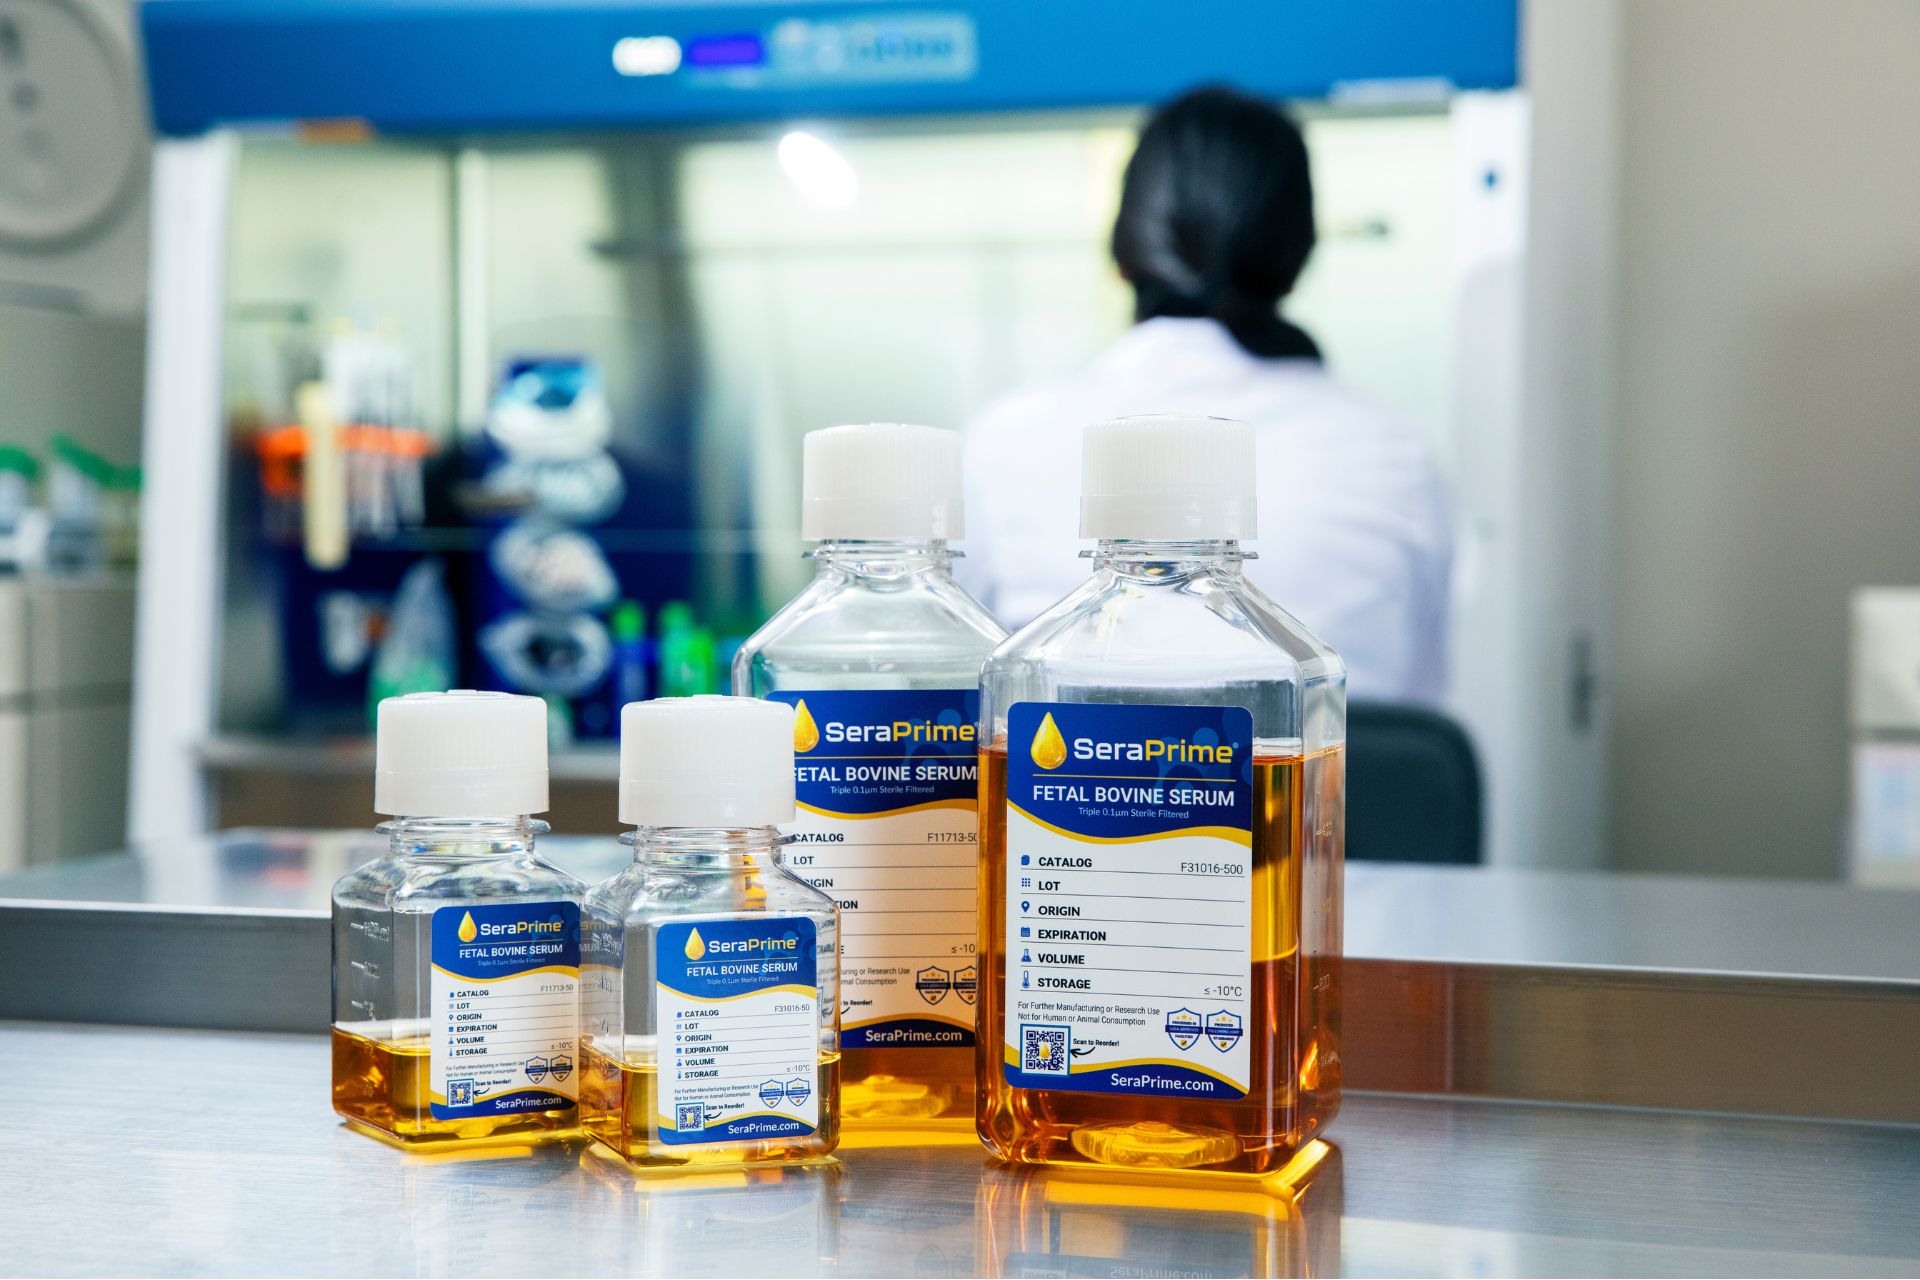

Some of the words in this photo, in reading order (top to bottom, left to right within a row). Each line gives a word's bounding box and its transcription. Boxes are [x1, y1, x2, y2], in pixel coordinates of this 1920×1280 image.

[846, 767, 911, 782] BOVINE
[916, 766, 977, 781] SERUM
[830, 786, 851, 795] Triple
[880, 786, 904, 794] Sterile
[905, 785, 935, 794] Filtered
[1033, 785, 1090, 802] FETAL
[1095, 787, 1164, 804] BOVINE
[1169, 789, 1235, 807] SERUM
[1078, 807, 1100, 817] Triple
[1131, 808, 1157, 818] Sterile
[1159, 809, 1189, 819] Filtered
[794, 856, 814, 865] LOT
[1039, 857, 1092, 868] CATALOG
[1181, 862, 1243, 875] F31016-500
[1039, 881, 1061, 891] LOT
[1039, 906, 1081, 917] ORIGIN
[1038, 930, 1106, 942] EXPIRATION
[460, 950, 490, 959] FETAL
[492, 946, 527, 957] BOVINE
[529, 944, 563, 955] SERUM
[1038, 954, 1085, 965] VOLUME
[687, 967, 719, 977] FETAL
[721, 964, 760, 975] BOVINE
[762, 962, 798, 973] SERUM
[855, 978, 897, 986] Consumption
[1038, 978, 1091, 990] STORAGE
[457, 990, 489, 998] CATALOG
[541, 984, 574, 993] F11713-50
[1213, 986, 1243, 997] -10°C
[685, 1010, 719, 1018] CATALOG
[775, 1004, 810, 1013] F31016-50
[1018, 1001, 1029, 1009] For
[1031, 1002, 1055, 1010] Further
[1057, 1003, 1104, 1014] Manufacturing
[1115, 1006, 1146, 1014] Research
[457, 1013, 482, 1021] ORIGIN
[1032, 1013, 1041, 1021] for
[1043, 1014, 1067, 1022] Human
[1077, 1015, 1100, 1024] Animal
[1102, 1016, 1146, 1026] Consumption
[457, 1024, 498, 1033] EXPIRATION
[457, 1037, 485, 1045] VOLUME
[866, 1029, 962, 1042] SeraPrime.com
[456, 1048, 488, 1057] STORAGE
[685, 1045, 729, 1055] EXPIRATION
[685, 1058, 715, 1067] VOLUME
[685, 1070, 719, 1079] STORAGE
[1111, 1073, 1214, 1091] SeraPrime.com
[496, 1097, 562, 1109] SeraPrime.com
[728, 1122, 800, 1134] SeraPrime.com
